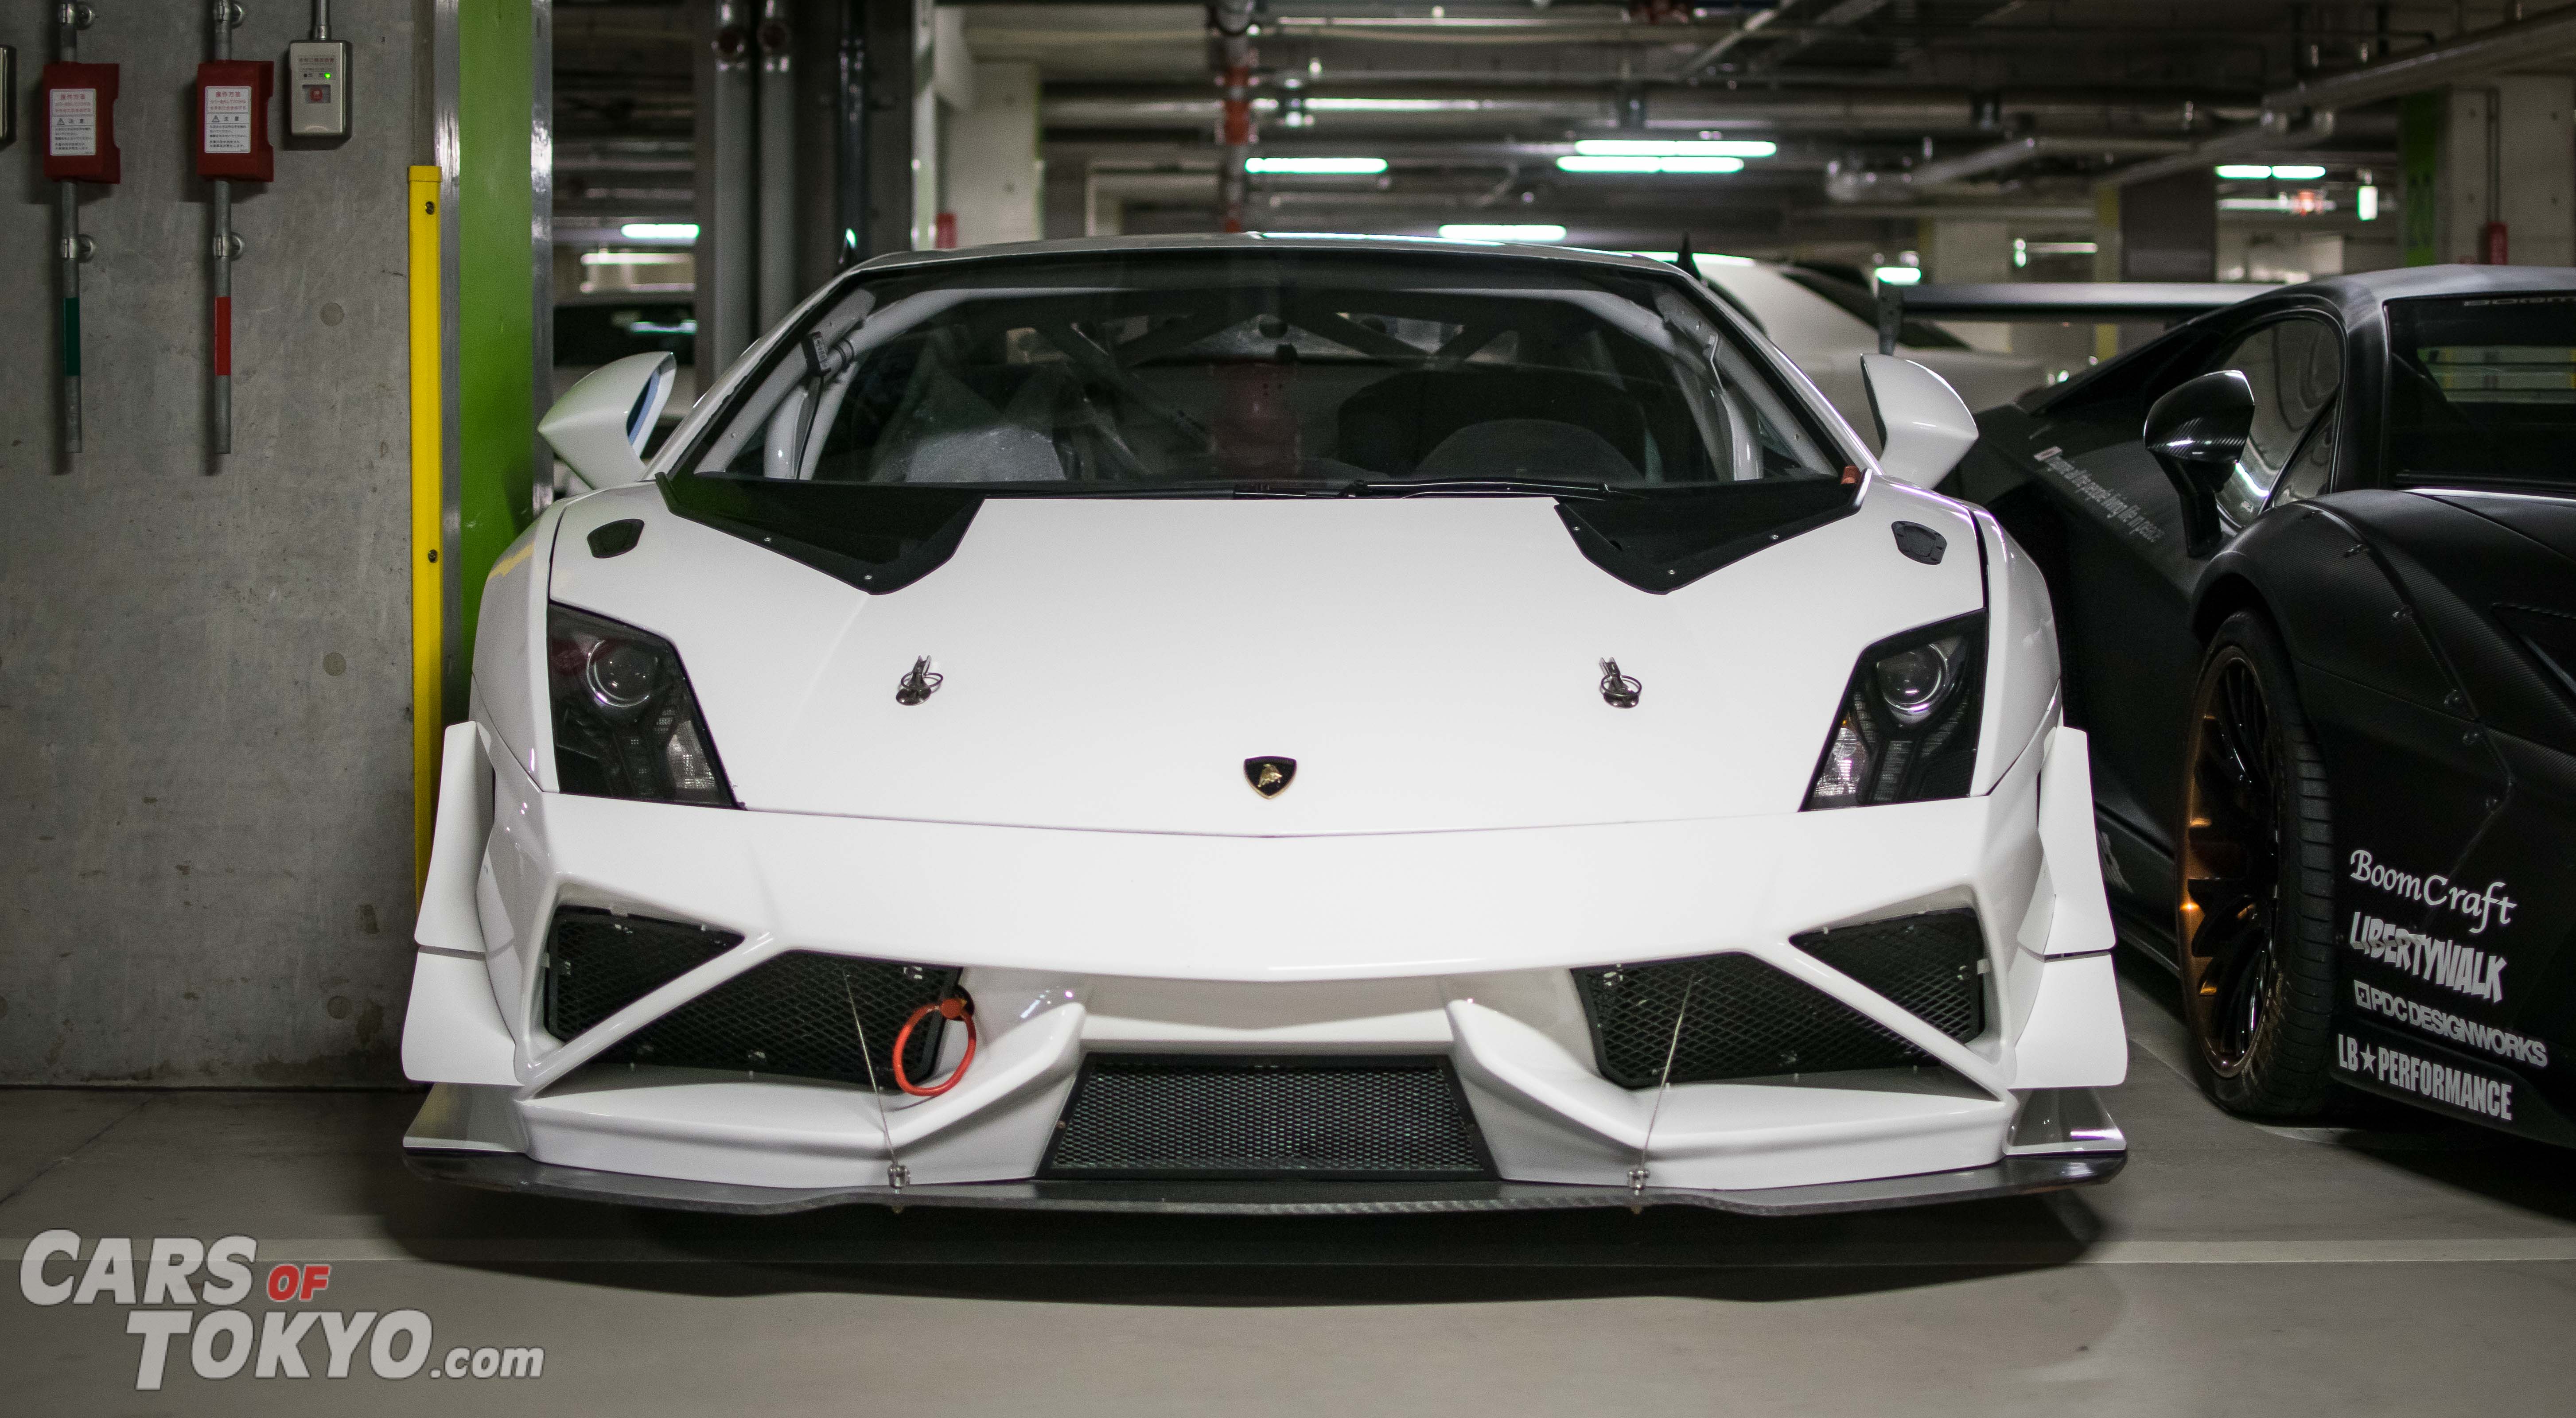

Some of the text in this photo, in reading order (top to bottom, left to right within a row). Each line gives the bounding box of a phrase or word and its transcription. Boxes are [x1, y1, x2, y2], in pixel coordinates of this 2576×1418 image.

[2350, 849, 2518, 934] BoomCraft
[2370, 987, 2548, 1067] PDC DESIGNWORKS
